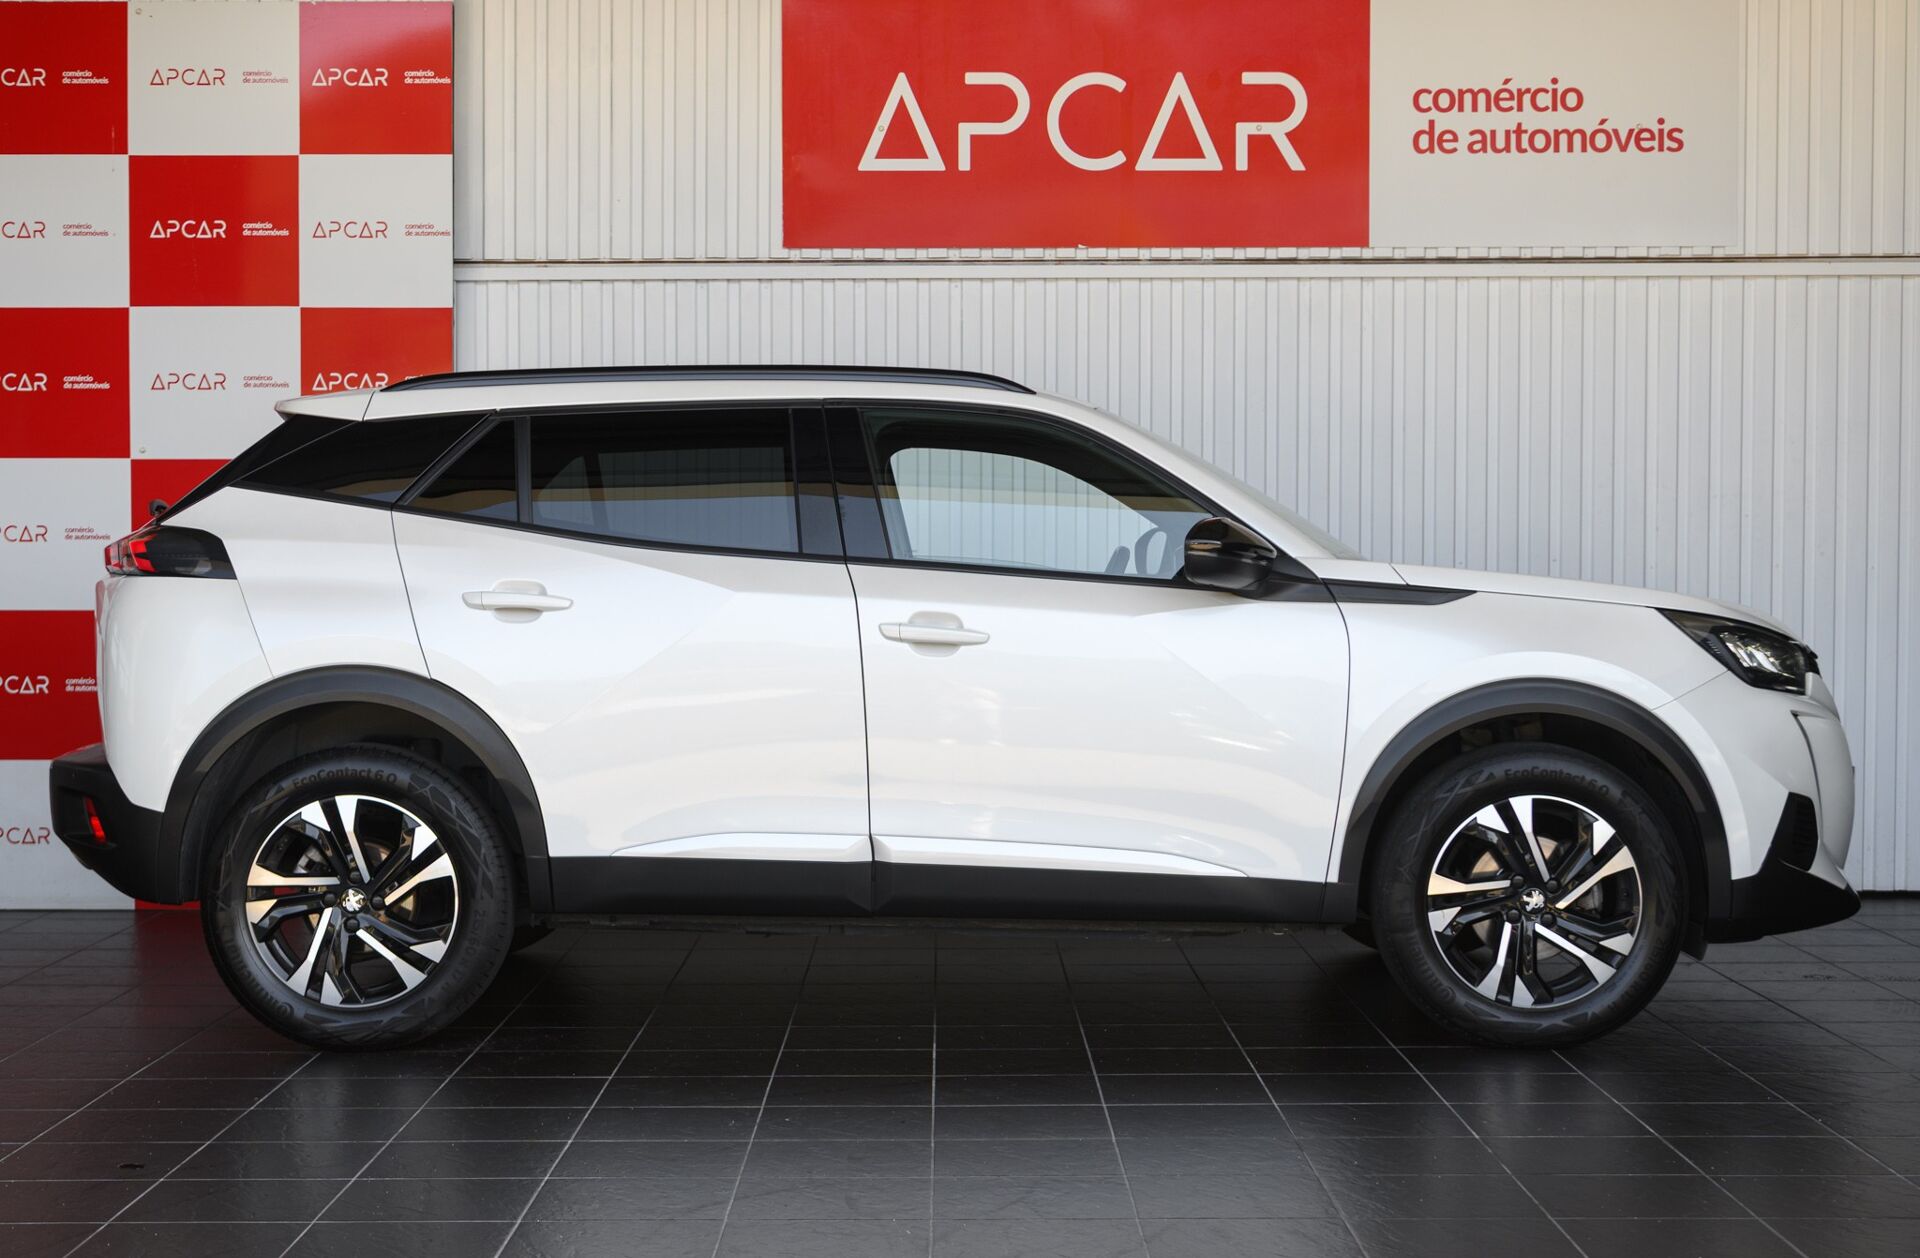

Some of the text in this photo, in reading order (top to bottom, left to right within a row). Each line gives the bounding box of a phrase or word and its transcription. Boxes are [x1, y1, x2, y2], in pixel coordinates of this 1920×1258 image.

[150, 68, 226, 86] APCAR
[312, 68, 388, 86] APCAR
[1412, 77, 1583, 114] comércio
[858, 72, 1308, 171] APCAR
[1412, 117, 1684, 154] de automóveis
[150, 220, 226, 238] APCAR
[312, 221, 388, 239] APCAR
[0, 373, 47, 391] CAR
[151, 373, 226, 390] APCAR
[312, 373, 388, 391] APCAR
[0, 525, 48, 542] CAR
[292, 766, 371, 789] EcoContact
[1504, 766, 1587, 785] EcoContact
